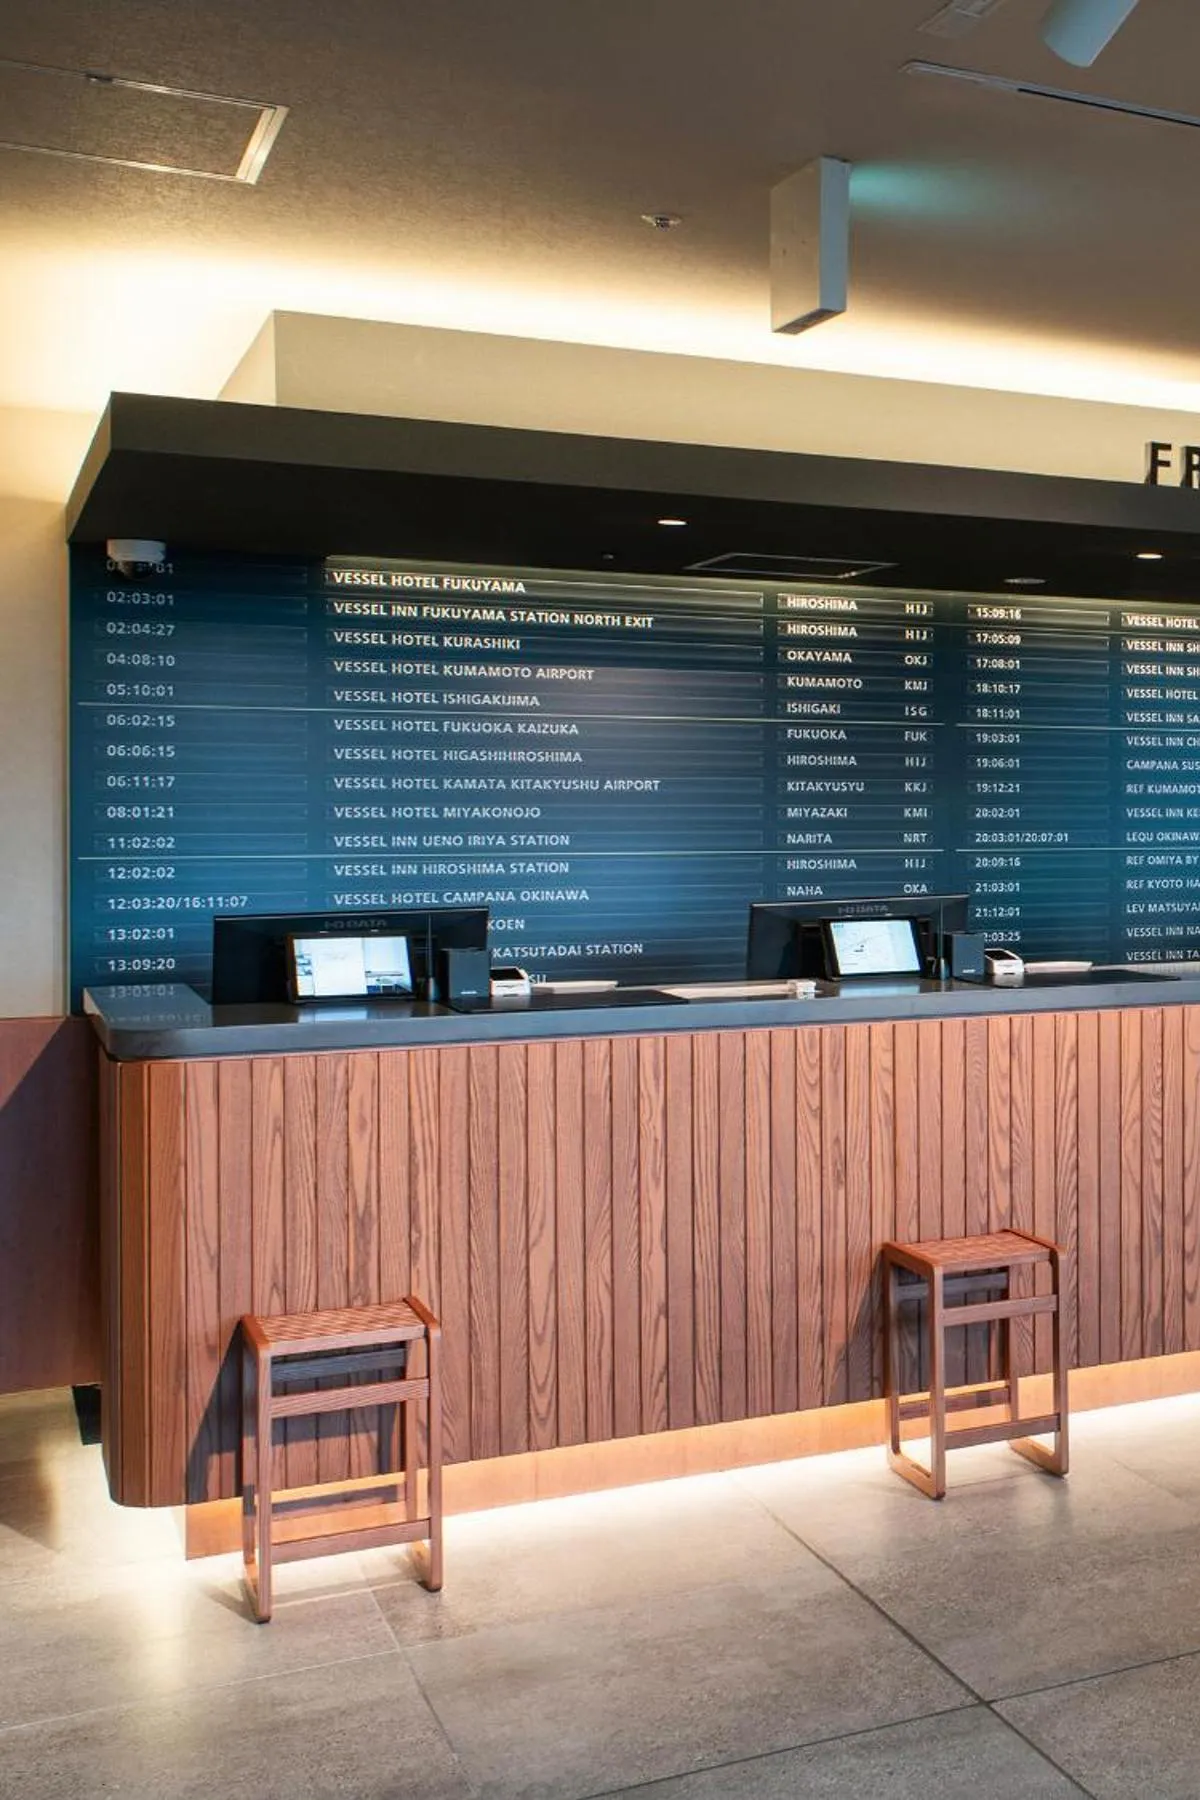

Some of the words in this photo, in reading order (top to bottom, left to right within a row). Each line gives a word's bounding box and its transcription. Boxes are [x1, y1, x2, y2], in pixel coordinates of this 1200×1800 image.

[334, 572, 387, 585] VESSEL
[392, 575, 438, 588] HOTEL
[444, 578, 526, 593] FUKUYAMA
[107, 592, 174, 605] 02:03:01
[787, 597, 857, 611] HIROSHIMA
[905, 603, 927, 615] HIJ
[976, 608, 1022, 620] 15:09:16
[334, 603, 387, 615] VESSEL
[392, 605, 417, 616] INN
[423, 606, 505, 621] FUKUYAMA
[510, 611, 569, 624] STATION
[575, 614, 620, 626] NORTH
[625, 616, 654, 628] EXIT
[1127, 616, 1163, 627] VESSEL
[1166, 618, 1198, 629] HOTEL
[107, 622, 175, 636] 02:04:27
[787, 624, 858, 637] HIROSHIMA
[905, 629, 927, 641] HIJ
[976, 634, 1020, 645] 17:05:09
[334, 632, 387, 644] VESSEL
[392, 634, 438, 646] HOTEL
[444, 636, 520, 650] KURASHIKI
[1127, 640, 1163, 651] VESSEL
[1166, 642, 1183, 652] INN
[107, 653, 175, 666] 04:08:10
[787, 651, 852, 663] OKAYAMA
[905, 655, 927, 666] OKJ
[976, 659, 1020, 670] 17:08:01
[1127, 664, 1163, 675] VESSEL
[1166, 666, 1183, 676] INN
[334, 661, 387, 673] VESSEL
[392, 663, 438, 675] HOTEL
[444, 665, 531, 678] KUMAMOTO
[536, 667, 594, 680] AIRPORT
[787, 677, 862, 689] KUMAMOTO
[905, 680, 927, 691] KMJ
[976, 683, 1020, 694] 18:10:17
[107, 684, 174, 696] 05:10:01
[1127, 689, 1163, 698] VESSEL
[1166, 690, 1198, 700] HOTEL
[334, 691, 387, 702] VESSEL
[392, 692, 438, 704] HOTEL
[444, 694, 539, 706] ISHIGAKIJIMA
[787, 703, 840, 714] ISHIGAKI
[905, 706, 927, 717] ISG
[976, 708, 1020, 719] 18:11:01
[107, 715, 175, 727] 06:02:15
[1127, 713, 1163, 722] VESSEL
[1166, 714, 1183, 723] INN
[334, 720, 387, 731] VESSEL
[392, 721, 438, 732] HOTEL
[444, 722, 512, 733] FUKUOKA
[518, 723, 578, 734] KAIZUKA
[787, 730, 847, 740] FUKUOKA
[905, 731, 927, 741] FUK
[976, 733, 1020, 743] 19:03:01
[1127, 736, 1163, 746] VESSEL
[1166, 737, 1183, 746] INN
[107, 746, 175, 757] 06:06:15
[334, 749, 387, 760] VESSEL
[392, 749, 438, 760] HOTEL
[444, 750, 582, 763] HIGASHIHIROSHIMA
[787, 755, 856, 766] HIROSHIMA
[905, 757, 927, 767] HIJ
[976, 758, 1020, 768] 19:06:01
[1127, 761, 1178, 770] CAMPANA
[107, 776, 175, 788] 06:11:17
[334, 778, 387, 789] VESSEL
[392, 779, 438, 789] HOTEL
[444, 779, 505, 790] KAMATA
[511, 779, 599, 790] KITAKYUSHU
[604, 780, 660, 791] AIRPORT
[787, 782, 864, 792] KITAKYUSYU
[904, 782, 927, 793] KKJ
[976, 783, 1020, 793] 19:12:21
[107, 806, 173, 818] 08:01:21
[334, 807, 387, 818] VESSEL
[392, 807, 438, 818] HOTEL
[444, 807, 540, 818] MIYAKONOJO
[787, 808, 847, 818] MIYAZAKI
[904, 808, 927, 818] KMI
[976, 808, 1020, 818] 20:02:01
[1127, 809, 1163, 817] VESSEL
[1166, 809, 1183, 817] INN
[334, 836, 387, 847] VESSEL
[392, 836, 417, 846] INN
[423, 836, 463, 846] UENO
[468, 835, 506, 846] IRIYA
[511, 835, 570, 846] STATION
[787, 834, 832, 844] NARITA
[904, 833, 927, 843] NRT
[976, 832, 1069, 843] 20:03:01/20:07:01
[1126, 832, 1154, 843] LEQU
[107, 838, 175, 849] 11:02:02
[787, 859, 856, 870] HIROSHIMA
[904, 858, 927, 868] HIJ
[976, 857, 1020, 868] 20:09:16
[107, 867, 175, 879] 12:02:02
[334, 865, 387, 875] VESSEL
[392, 864, 417, 875] INN
[423, 863, 505, 874] HIROSHIMA
[511, 862, 569, 874] STATION
[787, 885, 823, 895] NAHA
[904, 884, 927, 894] OKA
[976, 882, 1020, 893] 21:03:01
[107, 896, 247, 909] 12:03:20/16:11:07
[334, 894, 387, 905] VESSEL
[392, 892, 438, 904] HOTEL
[444, 891, 515, 903] CAMPANA
[520, 890, 589, 901] OKINAWA
[976, 907, 1020, 917] 21:12:01
[107, 928, 173, 940] 13:02:01
[1127, 928, 1163, 937] VESSEL
[1166, 927, 1183, 936] INN
[493, 946, 581, 958] KATSUTADAI
[586, 944, 642, 955] STATION
[107, 958, 175, 971] 13:09:20
